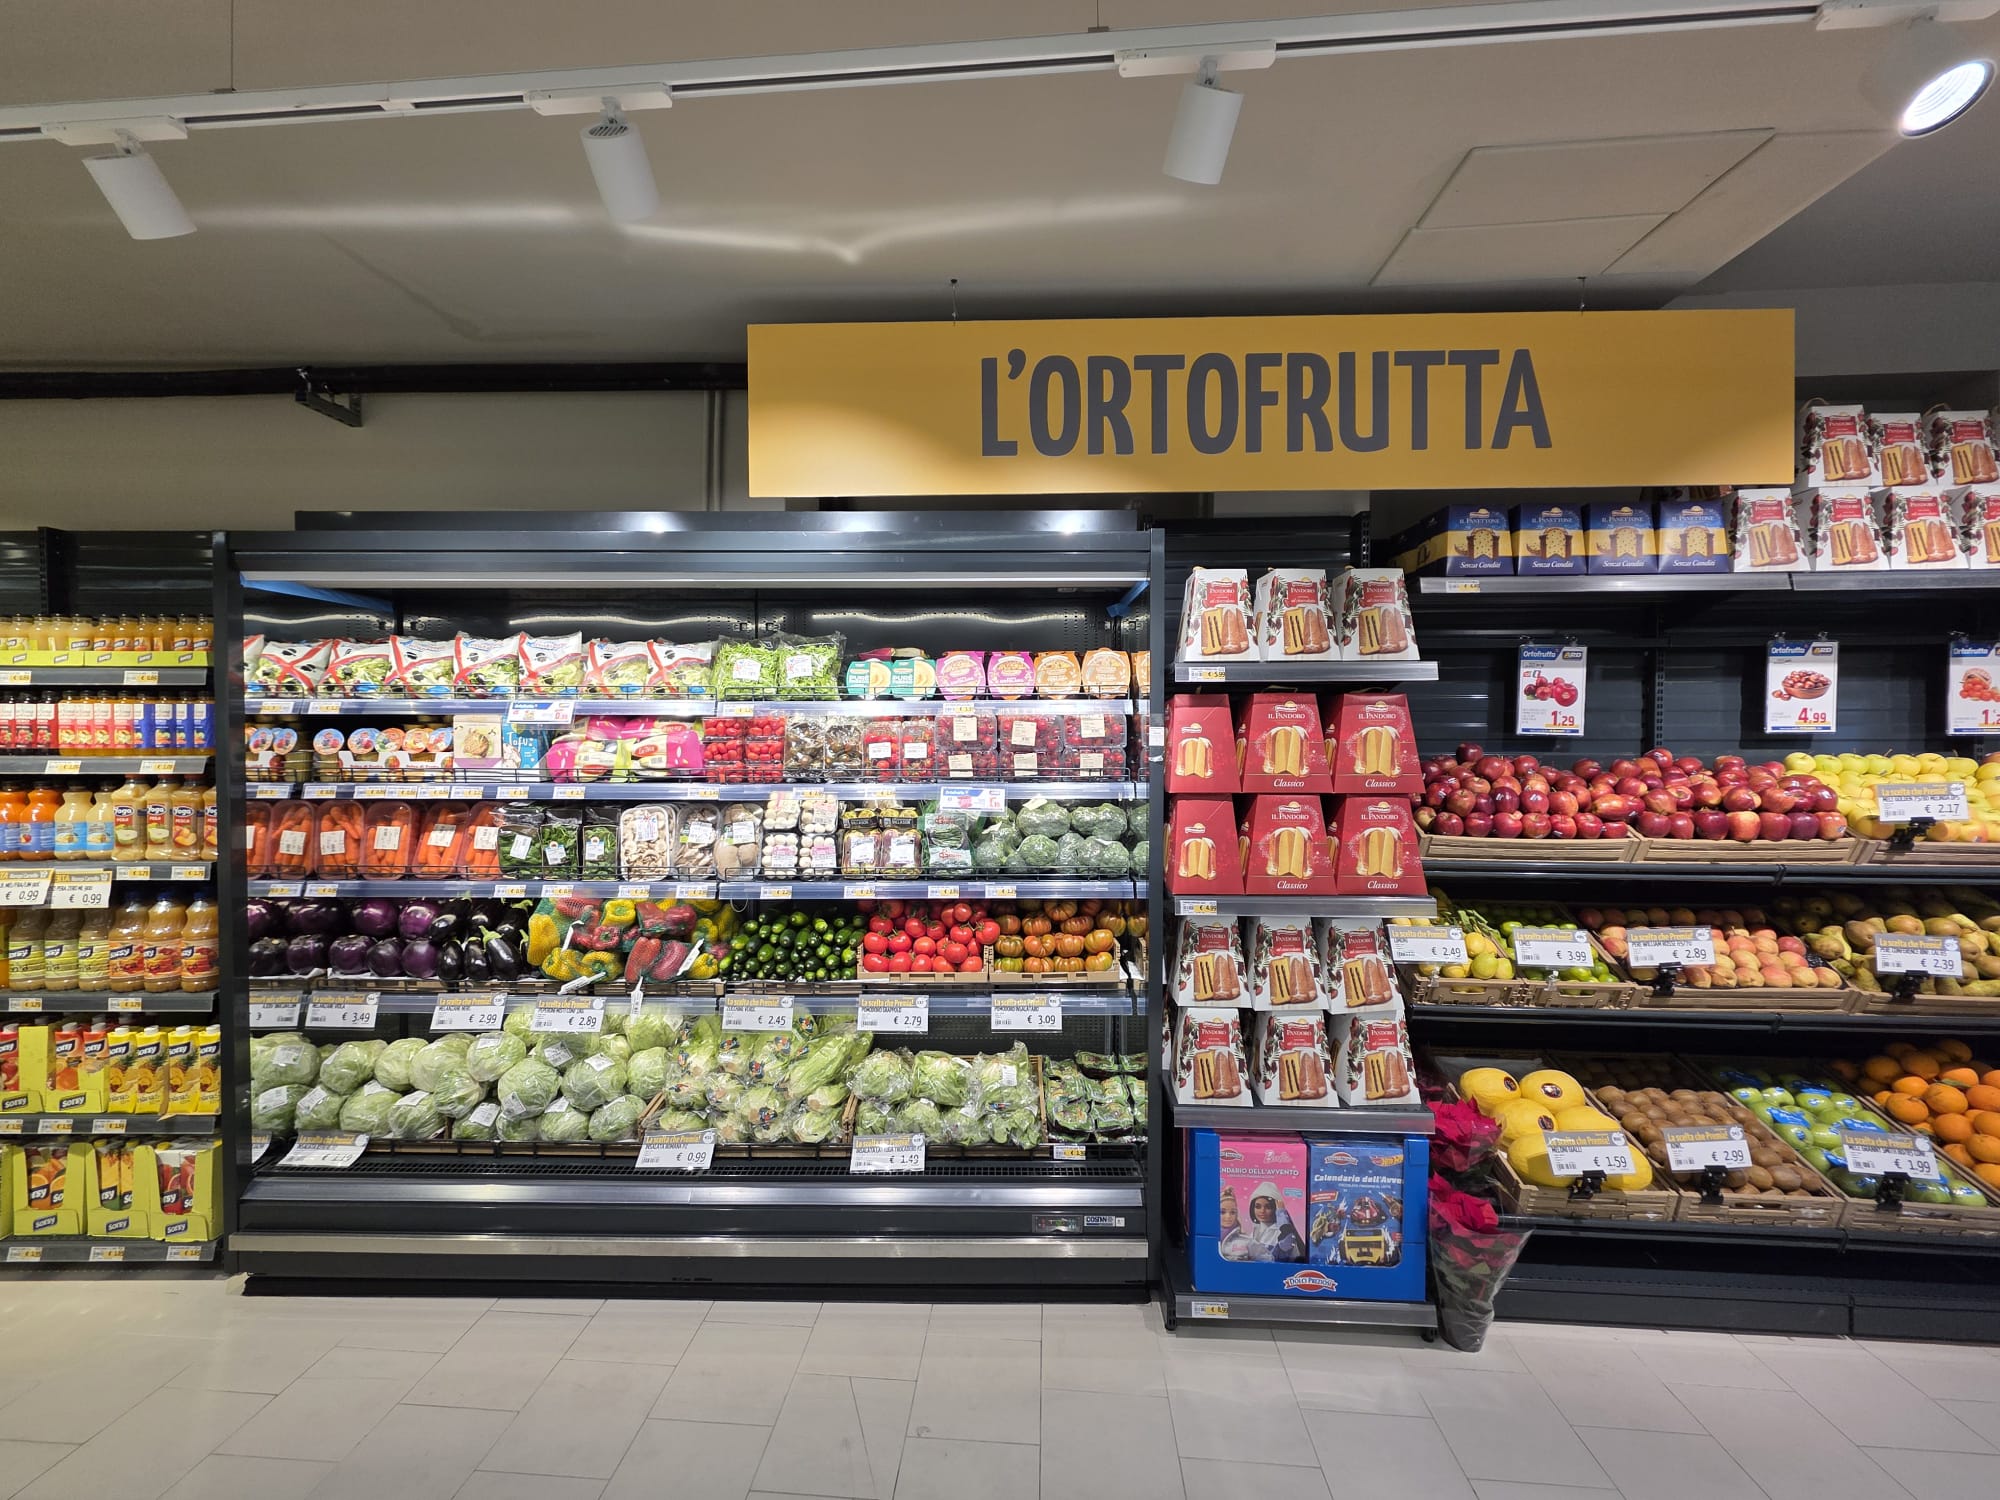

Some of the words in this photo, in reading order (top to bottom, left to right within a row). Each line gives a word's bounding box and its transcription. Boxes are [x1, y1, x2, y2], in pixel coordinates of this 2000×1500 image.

[981, 348, 1552, 456] L'ORTOFRUTTA
[1275, 711, 1306, 719] PANDORO
[1365, 711, 1397, 719] PANDORO
[506, 731, 528, 753] Tofu
[1273, 778, 1305, 788] Classico
[1365, 778, 1397, 788] Classico
[1278, 812, 1310, 820] PANDORO
[1368, 812, 1399, 820] PANDORO
[1276, 880, 1309, 890] Classico
[1367, 880, 1399, 890] Classico
[1442, 946, 1462, 958] 2.49
[1567, 950, 1587, 962] 3.99
[1684, 948, 1706, 960] 2.89
[1934, 958, 1954, 970] 2.39
[352, 1012, 370, 1023] 3.49
[478, 1014, 498, 1024] 2.99
[578, 1016, 597, 1028] 2.89
[768, 1015, 786, 1026] 2.45
[904, 1016, 922, 1026] 2.79
[1038, 1014, 1056, 1025] 3.09
[687, 1152, 707, 1163] 0.99
[900, 1154, 919, 1164] 1.49
[1723, 1150, 1744, 1162] 2.99
[1606, 1156, 1628, 1168] 1.59
[1908, 1159, 1931, 1173] 1.99
[1314, 1173, 1360, 1183] Calendario
[1361, 1175, 1403, 1185] dell'Avve
